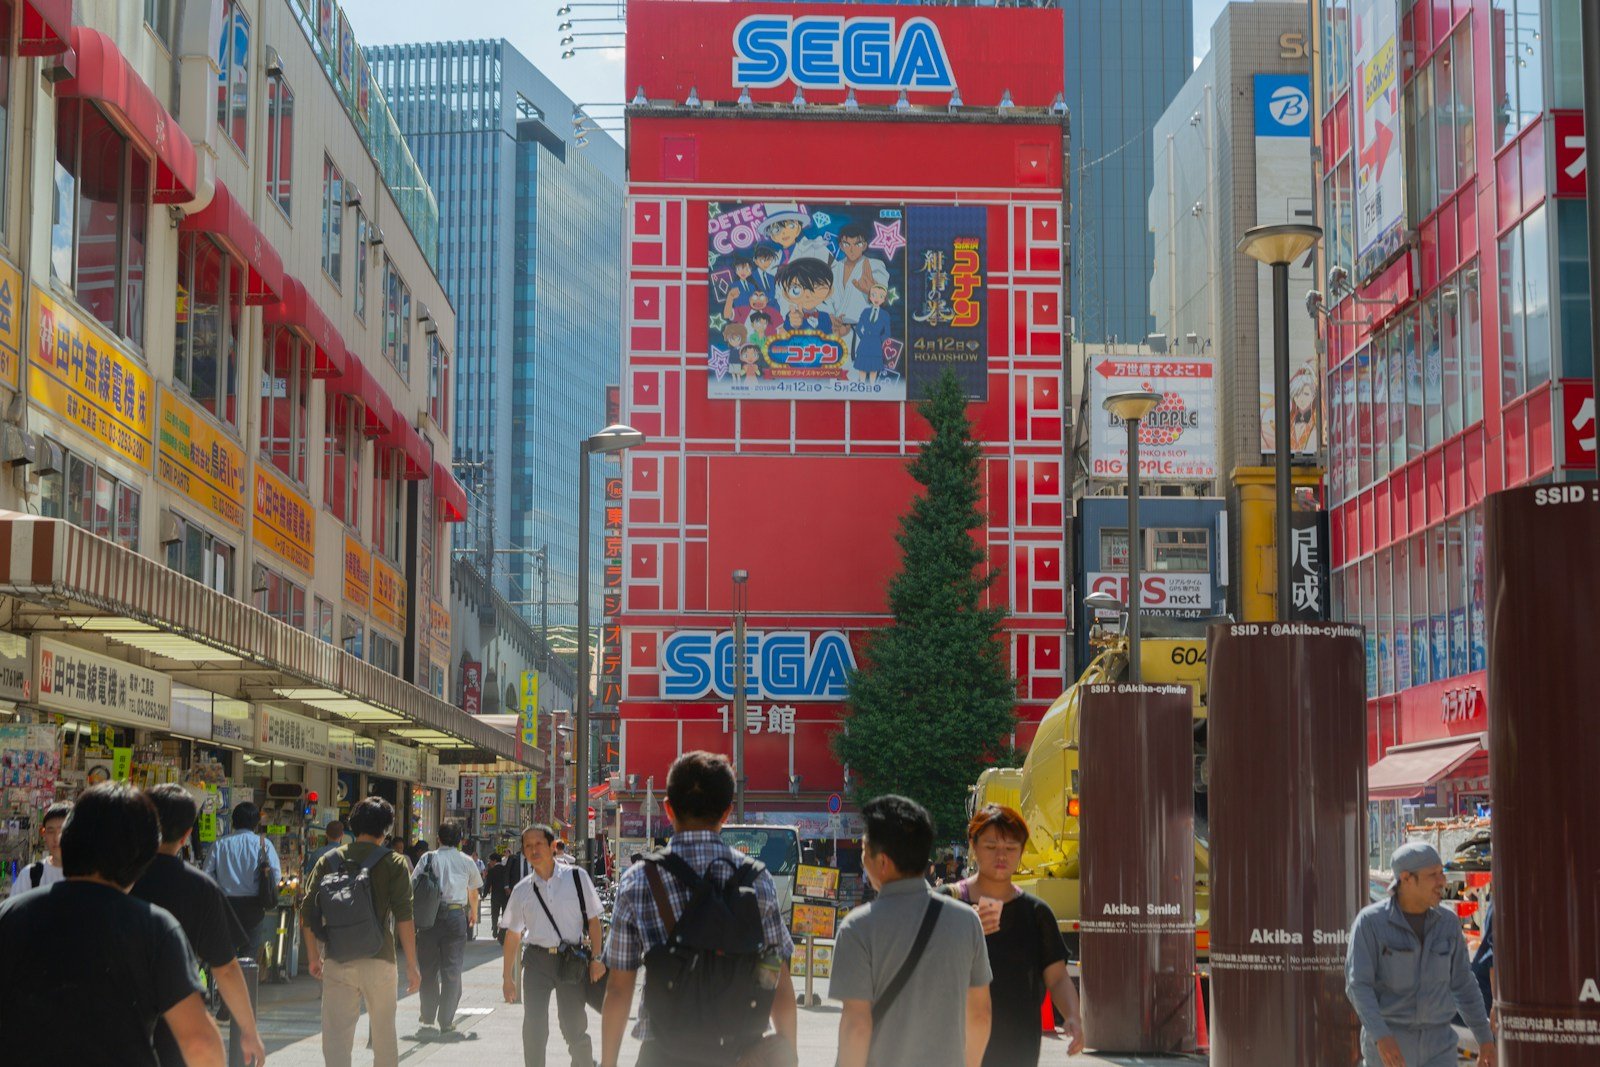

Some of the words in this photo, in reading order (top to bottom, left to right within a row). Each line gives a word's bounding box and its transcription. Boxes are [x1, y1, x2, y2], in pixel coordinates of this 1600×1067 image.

[732, 14, 958, 92] SEGA
[880, 209, 902, 219] SEGA
[951, 250, 981, 327] コナン
[786, 343, 839, 363] コナン
[914, 352, 978, 362] ROADSHOW
[1147, 410, 1198, 428] APPLE
[1094, 459, 1123, 473] BIG
[1128, 460, 1176, 475] PPLE.
[1535, 486, 1585, 505] SSID
[1169, 594, 1202, 604] next
[1231, 625, 1259, 636] SSID
[1270, 624, 1362, 638] @Akiba-cylinder
[661, 630, 858, 701] SEGA
[1091, 685, 1110, 693] SSID
[1441, 685, 1479, 723] カラオケ
[717, 704, 796, 735] 1号館
[464, 779, 473, 807] お弁当
[1103, 903, 1140, 914] Akiba
[1250, 928, 1303, 944] Akiba
